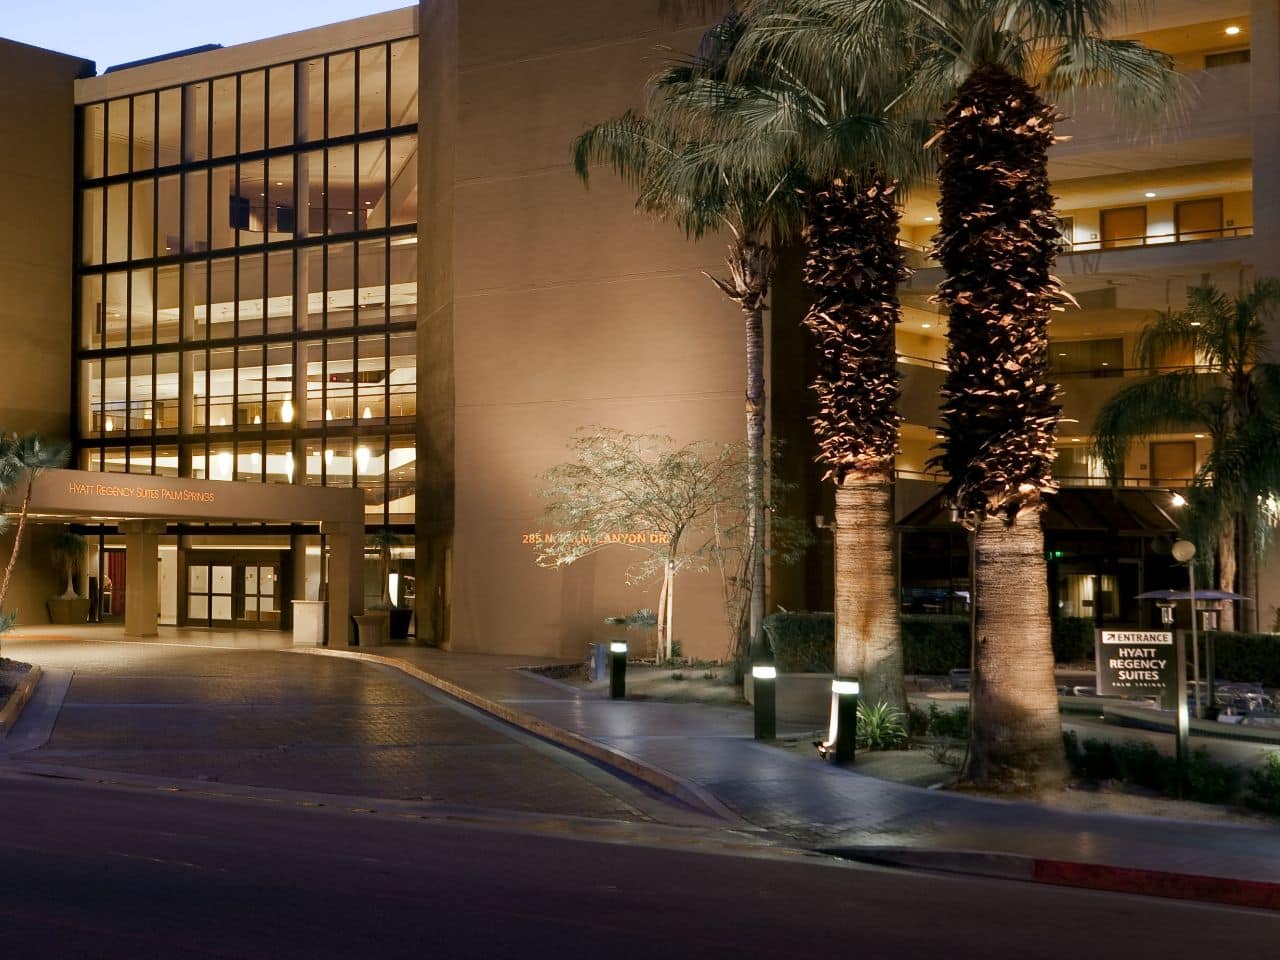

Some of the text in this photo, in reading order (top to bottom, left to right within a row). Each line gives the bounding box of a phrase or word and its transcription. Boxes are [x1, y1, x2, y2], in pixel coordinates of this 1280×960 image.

[69, 482, 215, 502] HYATT REGENCY SUITES PALM SPRINGS
[522, 533, 542, 545] 285
[1117, 633, 1169, 642] ENTRANCE
[1119, 647, 1157, 658] HYATT
[1109, 659, 1167, 670] REGENCY
[1118, 670, 1160, 680] SUITES
